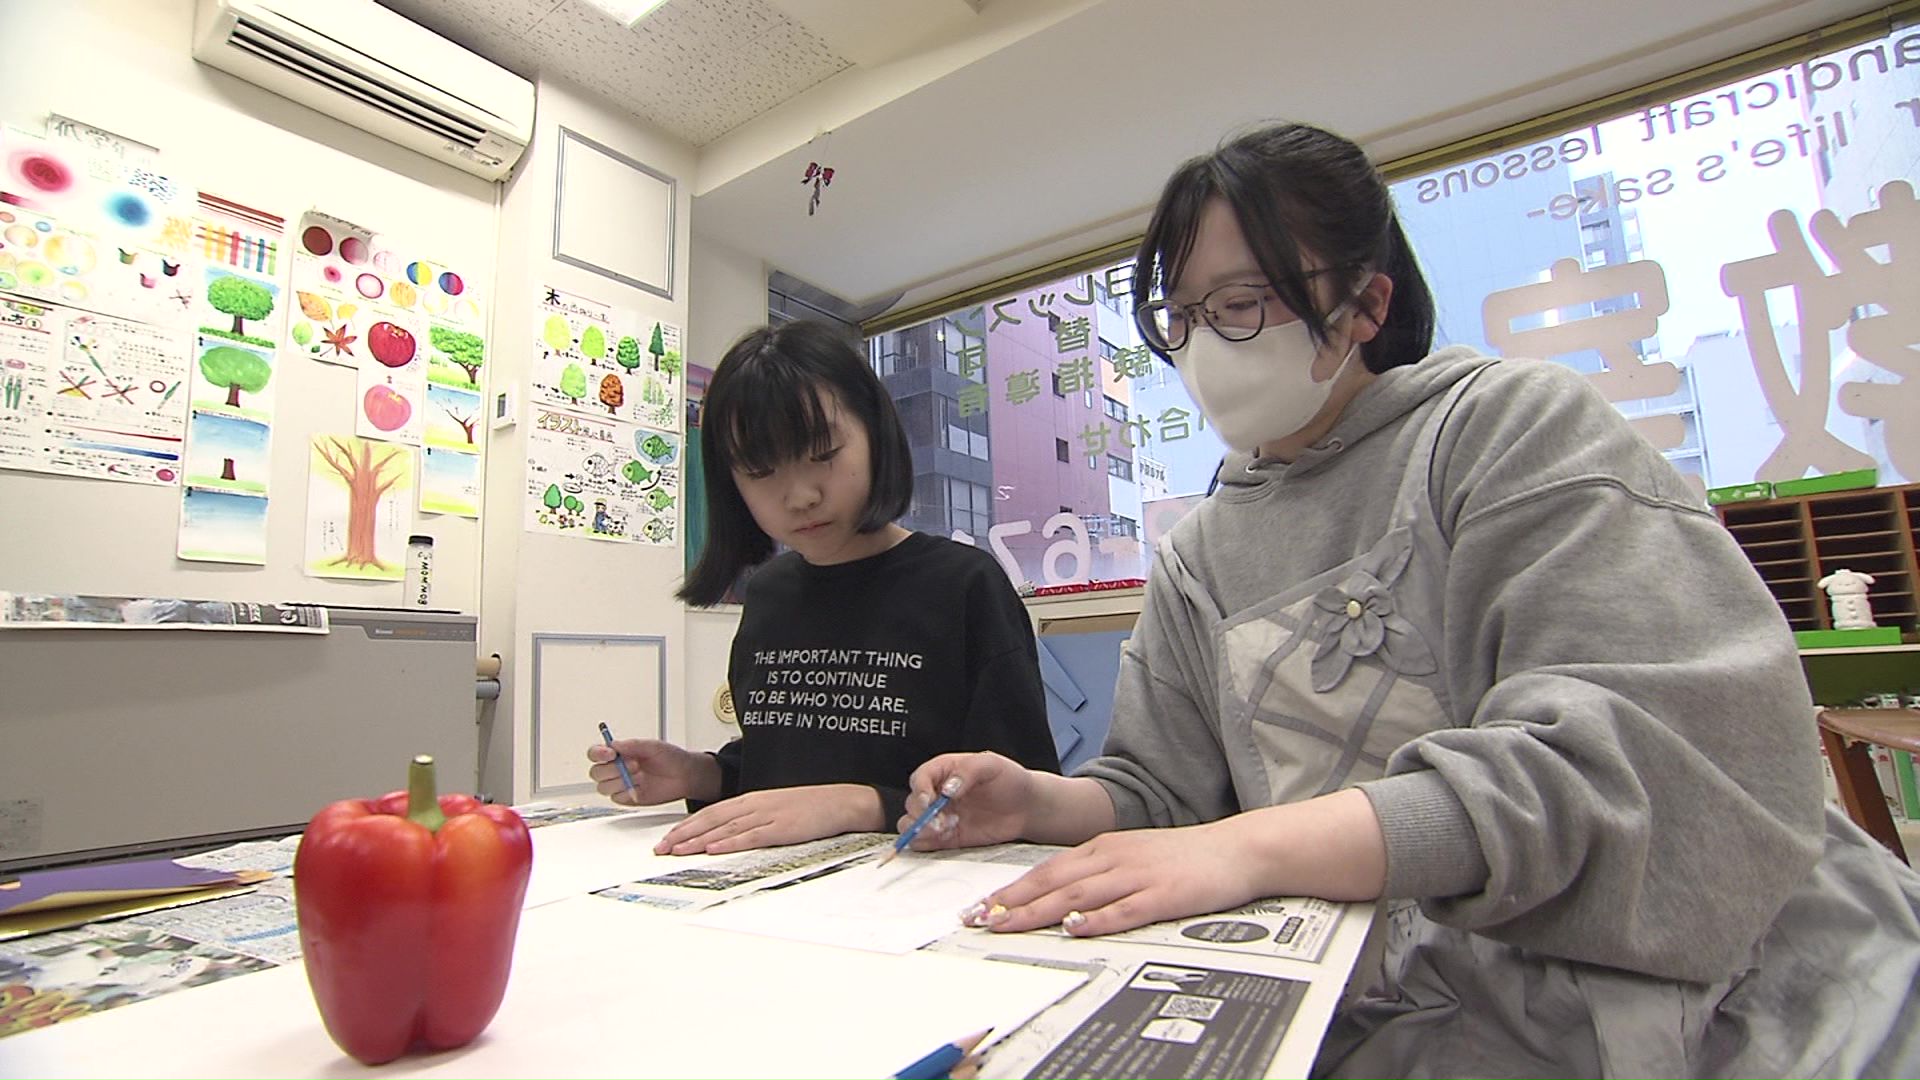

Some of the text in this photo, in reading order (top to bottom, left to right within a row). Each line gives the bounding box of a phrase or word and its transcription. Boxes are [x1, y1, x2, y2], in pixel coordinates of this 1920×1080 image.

[754, 649, 923, 669] THE IMPORTANT THING
[767, 670, 888, 688] IS TO CONTINUE
[749, 691, 909, 714] TO BE WHO YOU ARE.
[743, 711, 907, 737] BELIEVE IN YOURSELF!
